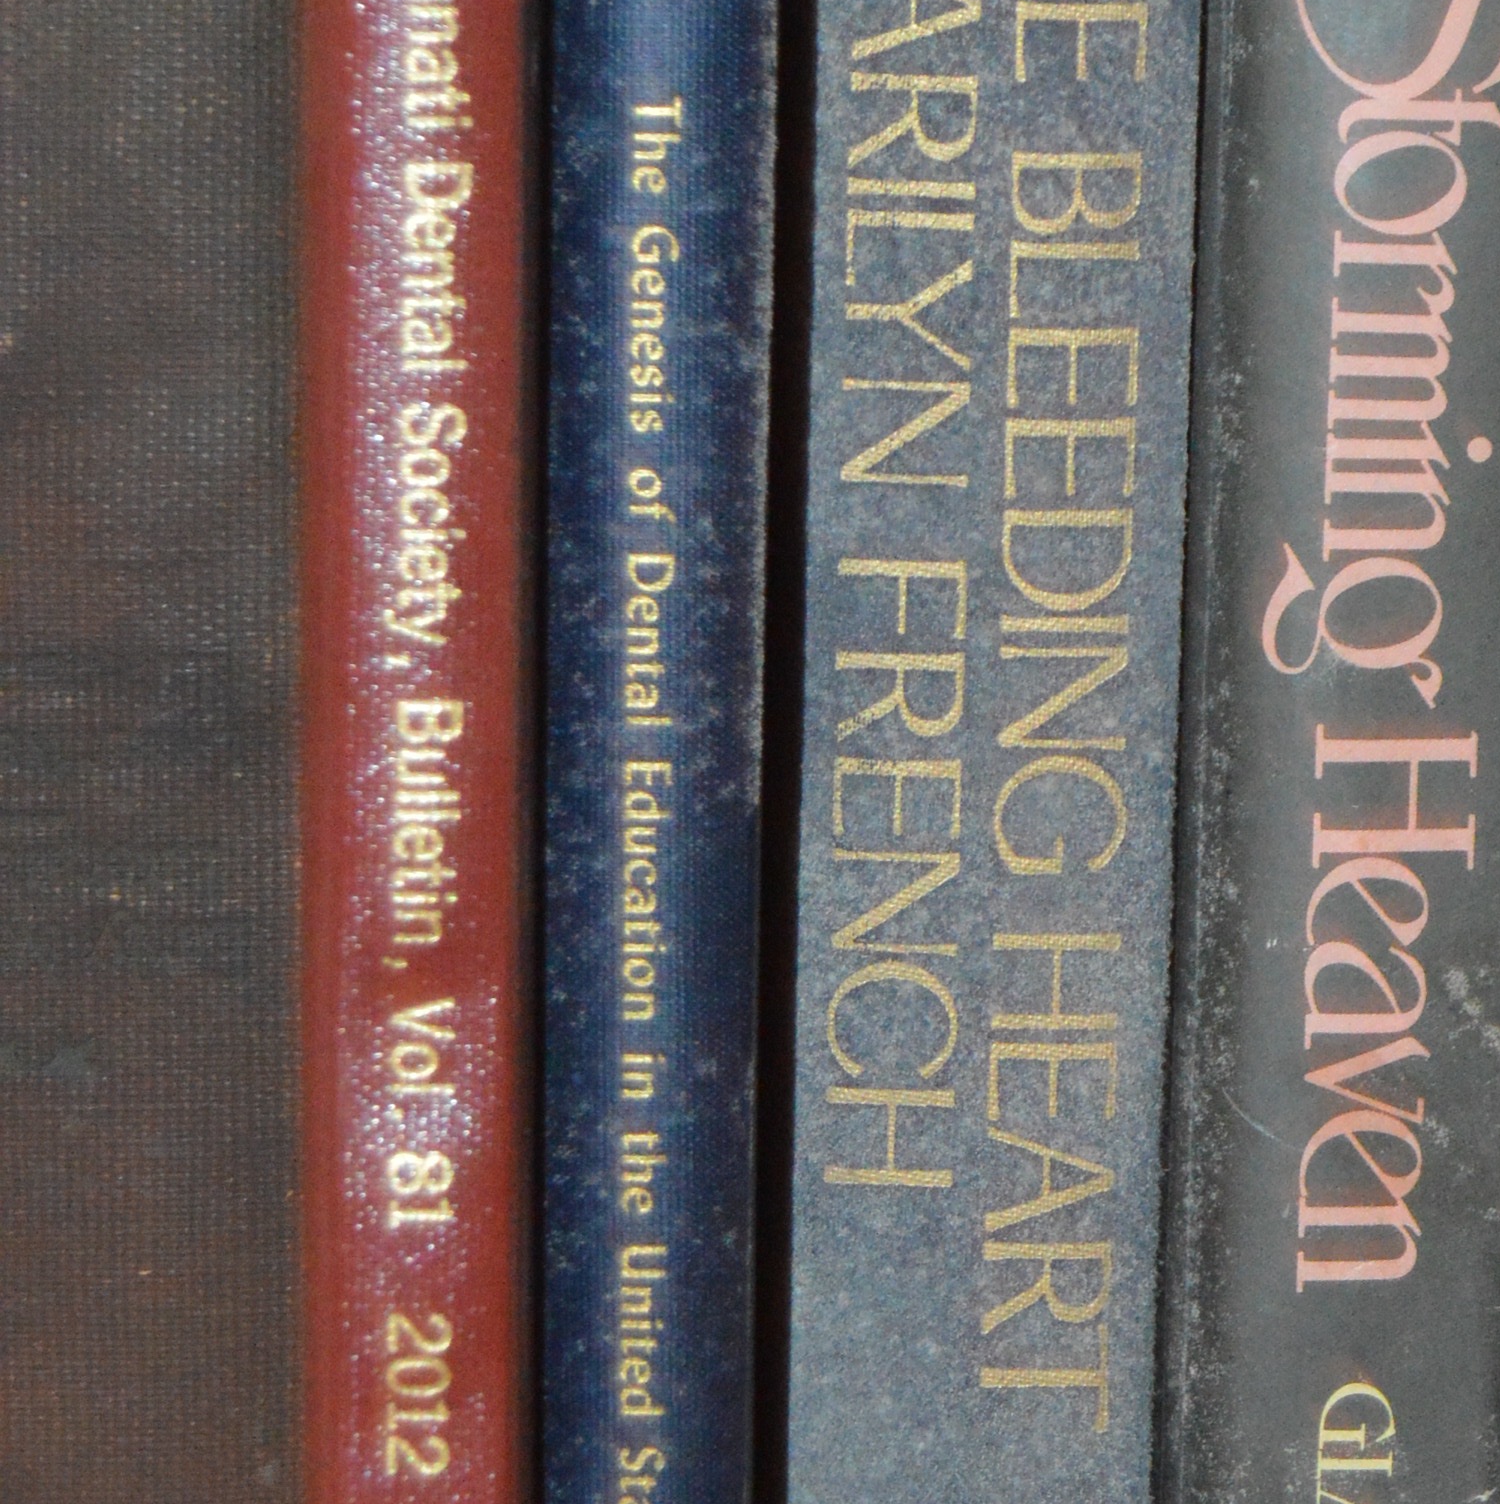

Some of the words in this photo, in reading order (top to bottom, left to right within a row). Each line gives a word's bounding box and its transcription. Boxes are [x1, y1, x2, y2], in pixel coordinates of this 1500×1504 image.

[630, 97, 683, 195] The
[399, 162, 474, 372] Dental
[627, 224, 681, 434] Genesis
[382, 403, 469, 668] Society,
[626, 468, 678, 523] of
[993, 151, 1143, 876] BLEEDING
[622, 553, 676, 727] Dental
[383, 699, 464, 969] Bulletin,
[621, 759, 673, 1023] Education
[824, 558, 967, 1187] FRENCH
[388, 996, 457, 1122] Vol.
[620, 1052, 667, 1101] in
[1295, 724, 1479, 1293] Heaven
[384, 1150, 456, 1228] 81
[619, 1131, 667, 1214] the
[980, 932, 1123, 1432] HEART
[384, 1311, 453, 1477] 2012
[617, 1243, 668, 1418] United
